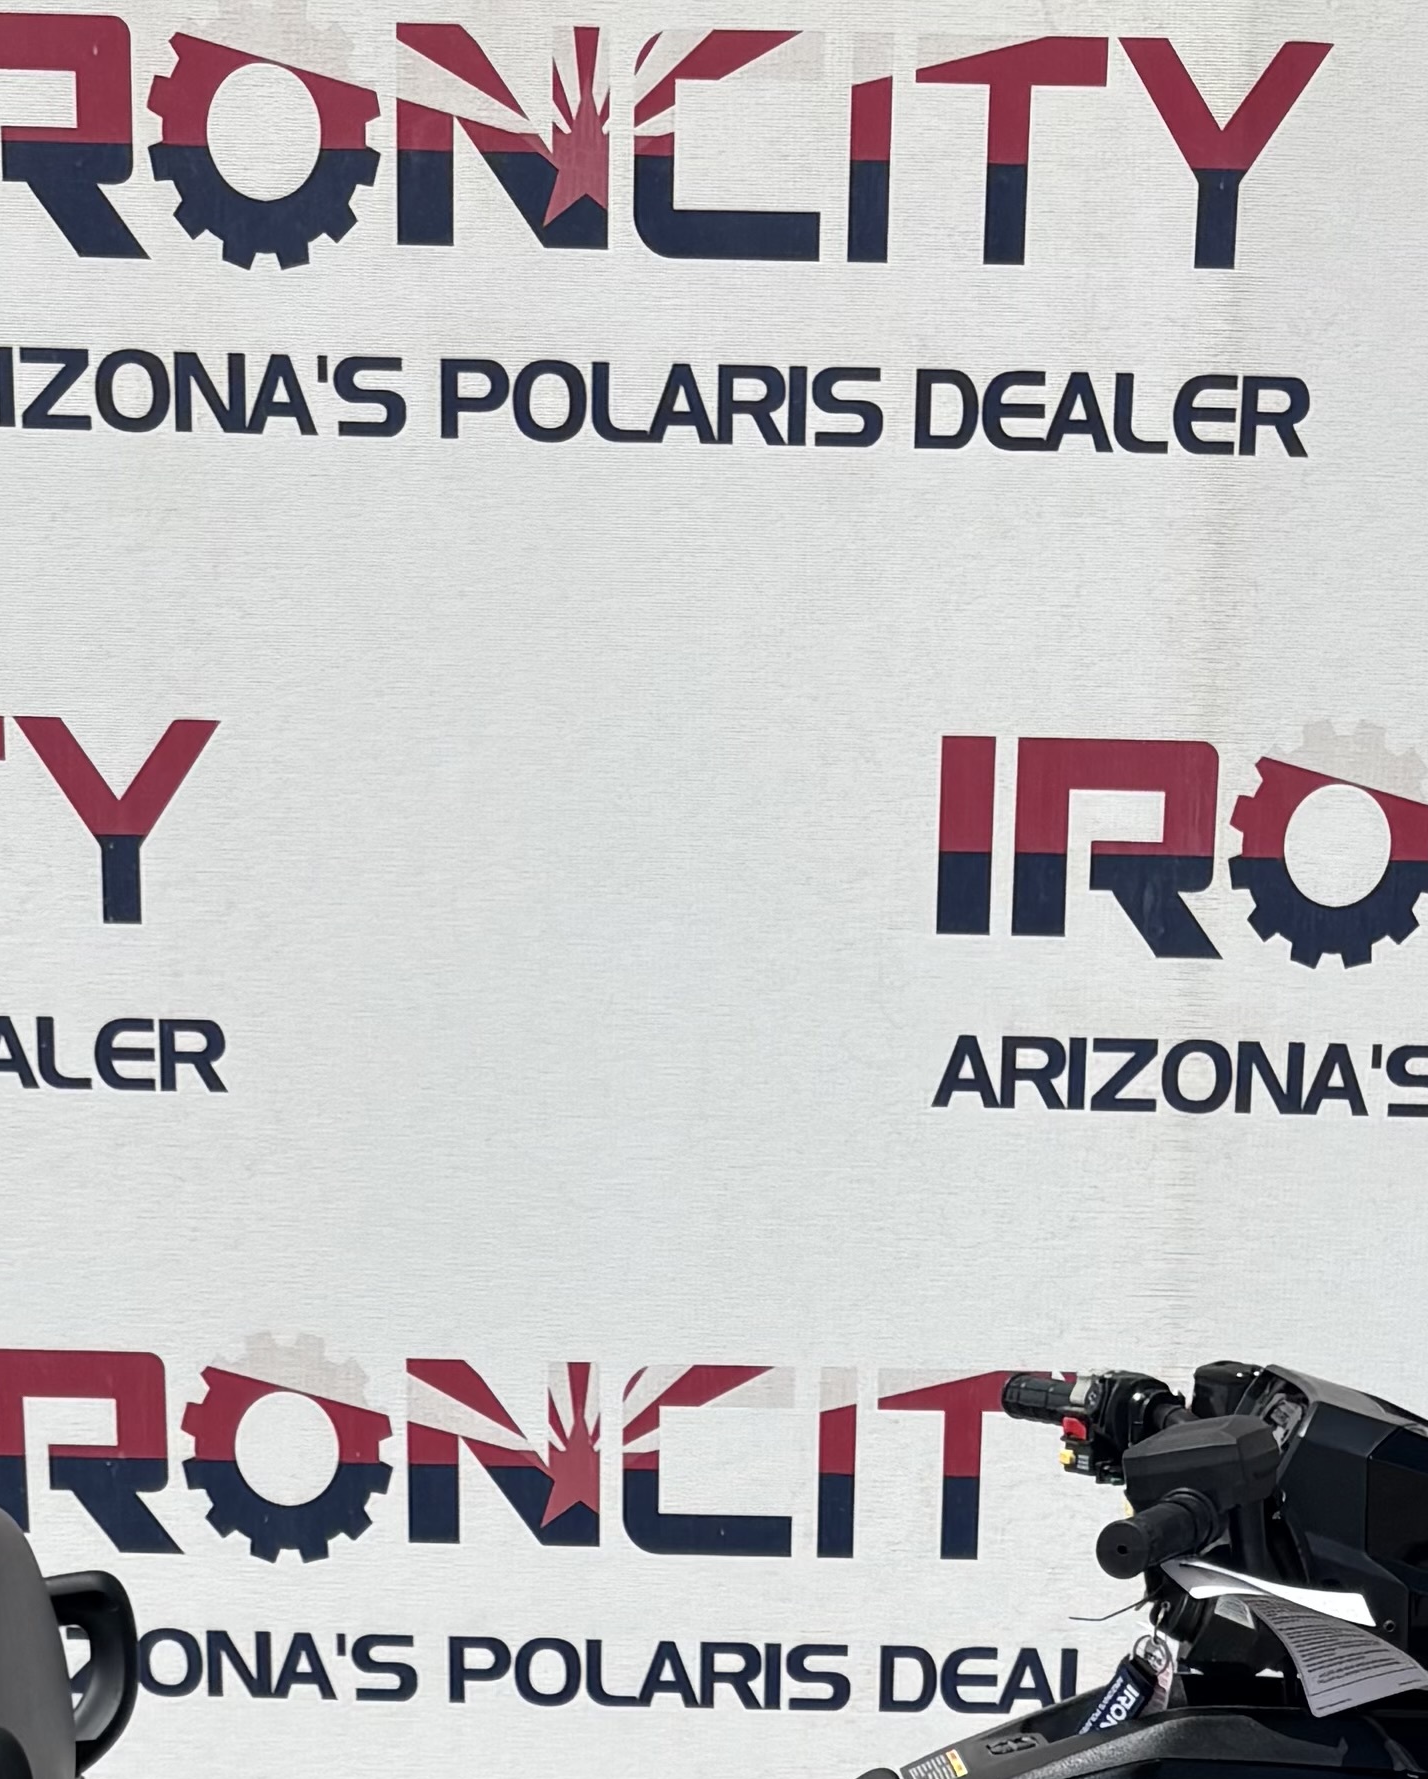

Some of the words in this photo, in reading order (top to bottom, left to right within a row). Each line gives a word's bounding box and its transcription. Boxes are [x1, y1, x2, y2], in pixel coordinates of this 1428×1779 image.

[440, 358, 883, 447] POLARIS
[914, 369, 1310, 457] DEALER
[449, 1636, 850, 1710] POLARIS
